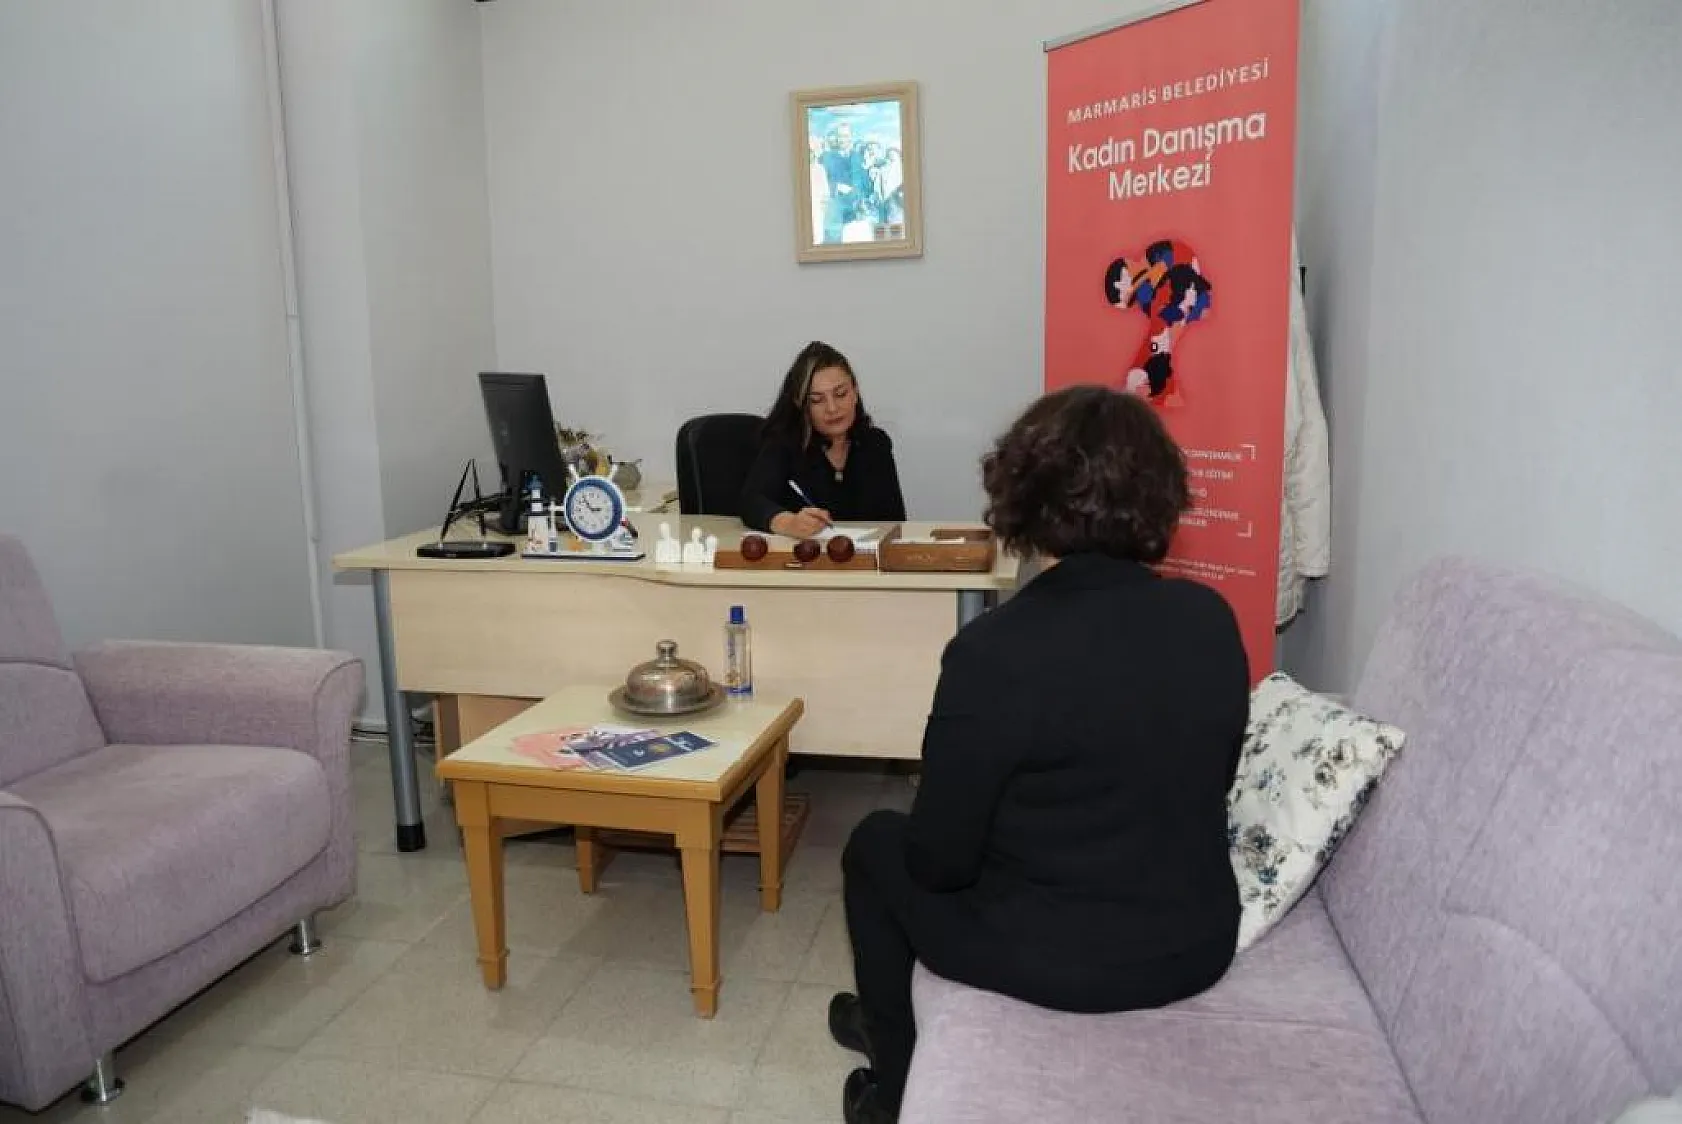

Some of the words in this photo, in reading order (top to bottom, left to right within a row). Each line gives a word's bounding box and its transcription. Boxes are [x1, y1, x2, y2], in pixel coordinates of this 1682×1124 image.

[1067, 86, 1157, 123] MARMARİS
[1162, 55, 1269, 100] BELEDİYESİ
[1068, 136, 1136, 173] Kadın
[1143, 112, 1267, 158] Danışma
[1108, 153, 1212, 201] Merkezi
